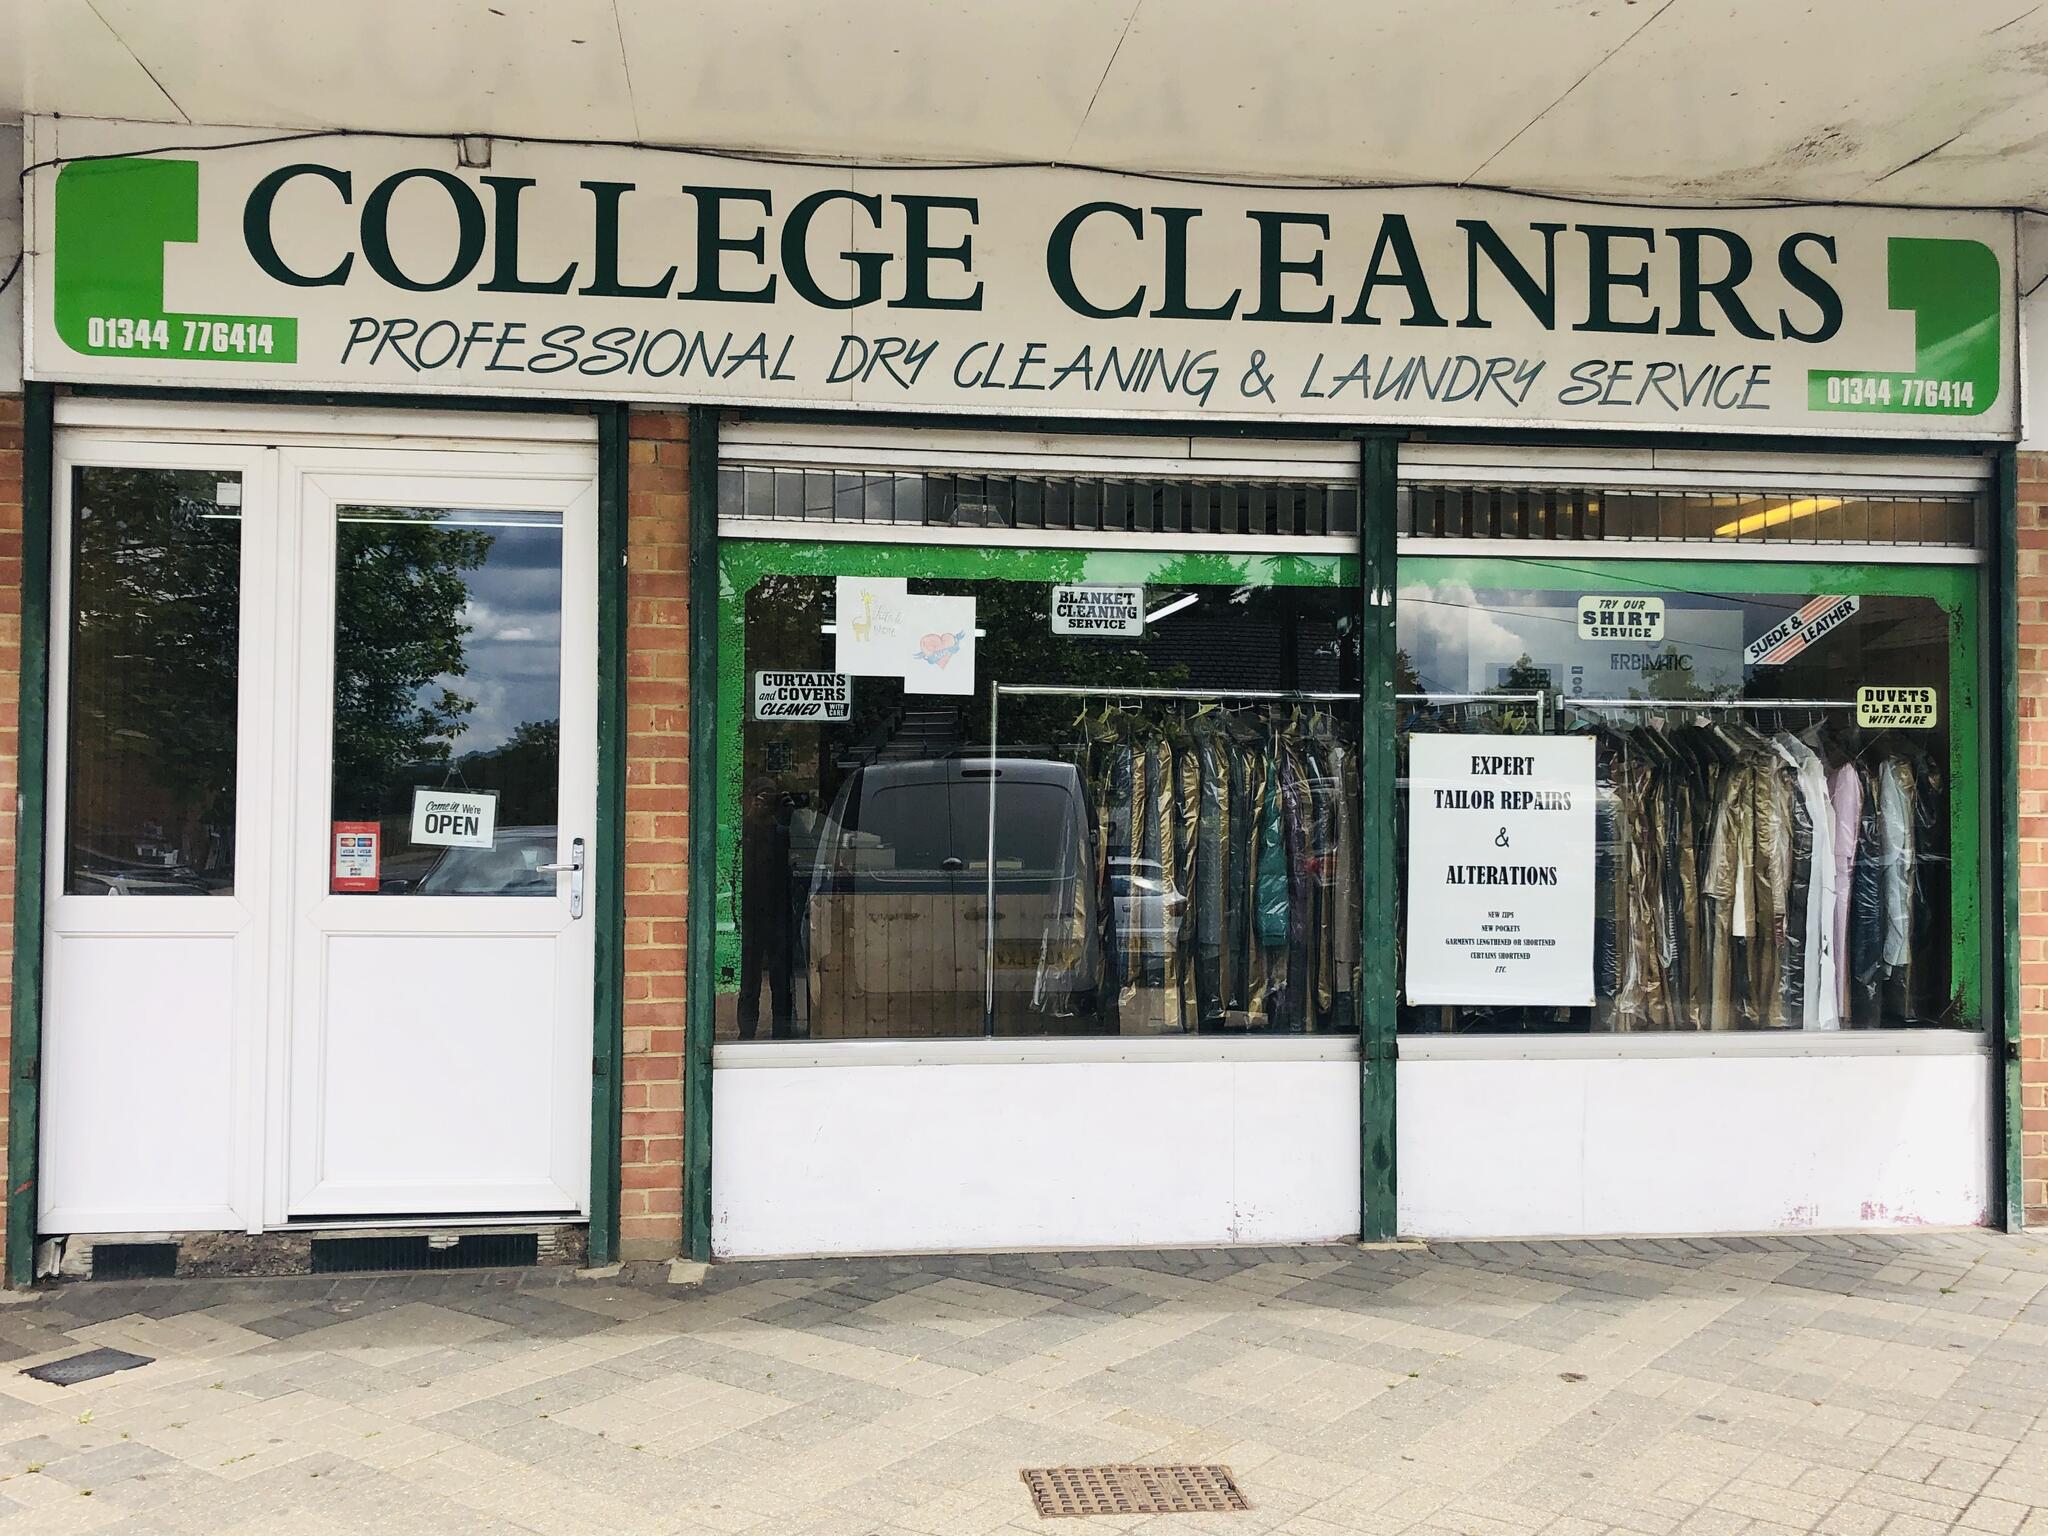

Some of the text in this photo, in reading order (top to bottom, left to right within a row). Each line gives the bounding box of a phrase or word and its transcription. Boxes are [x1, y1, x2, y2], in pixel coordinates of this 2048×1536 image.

[243, 163, 1843, 344] COLLEGE CLEANERS
[88, 317, 274, 354] 01344 776414
[341, 316, 1772, 412] PROFESSIONAL DRY CLEANING & LAUNDRY SERVICE
[1827, 376, 1974, 409] 01344 776414
[1058, 591, 1135, 605] BLANKET
[1599, 600, 1646, 610] TRY OUR
[1056, 605, 1137, 619] CLEANING
[1583, 611, 1660, 626] SHIRT
[1068, 619, 1126, 629] SERVICE
[1801, 600, 1855, 644] LEATHER
[1591, 627, 1652, 637] SERVICE
[1750, 616, 1803, 658] SUEDE &
[763, 674, 846, 686] CURTAINS
[759, 688, 846, 700] and COVERS
[1864, 689, 1929, 703] DUVETS
[760, 703, 821, 716] CLEANED
[1862, 704, 1933, 714] CLEANED
[1868, 715, 1927, 725] WITH CARE
[1471, 756, 1535, 776] EXPERT
[1434, 789, 1572, 811] TAILOR REPAIRS
[425, 801, 482, 815] Come in We're
[424, 813, 479, 836] OPEN
[1494, 826, 1510, 847] &
[1446, 865, 1558, 886] ALTERATIONS
[1487, 911, 1514, 919] NEW ZIPS
[1476, 938, 1512, 946] LENGTHENED
[1498, 952, 1531, 960] SHORTENED
